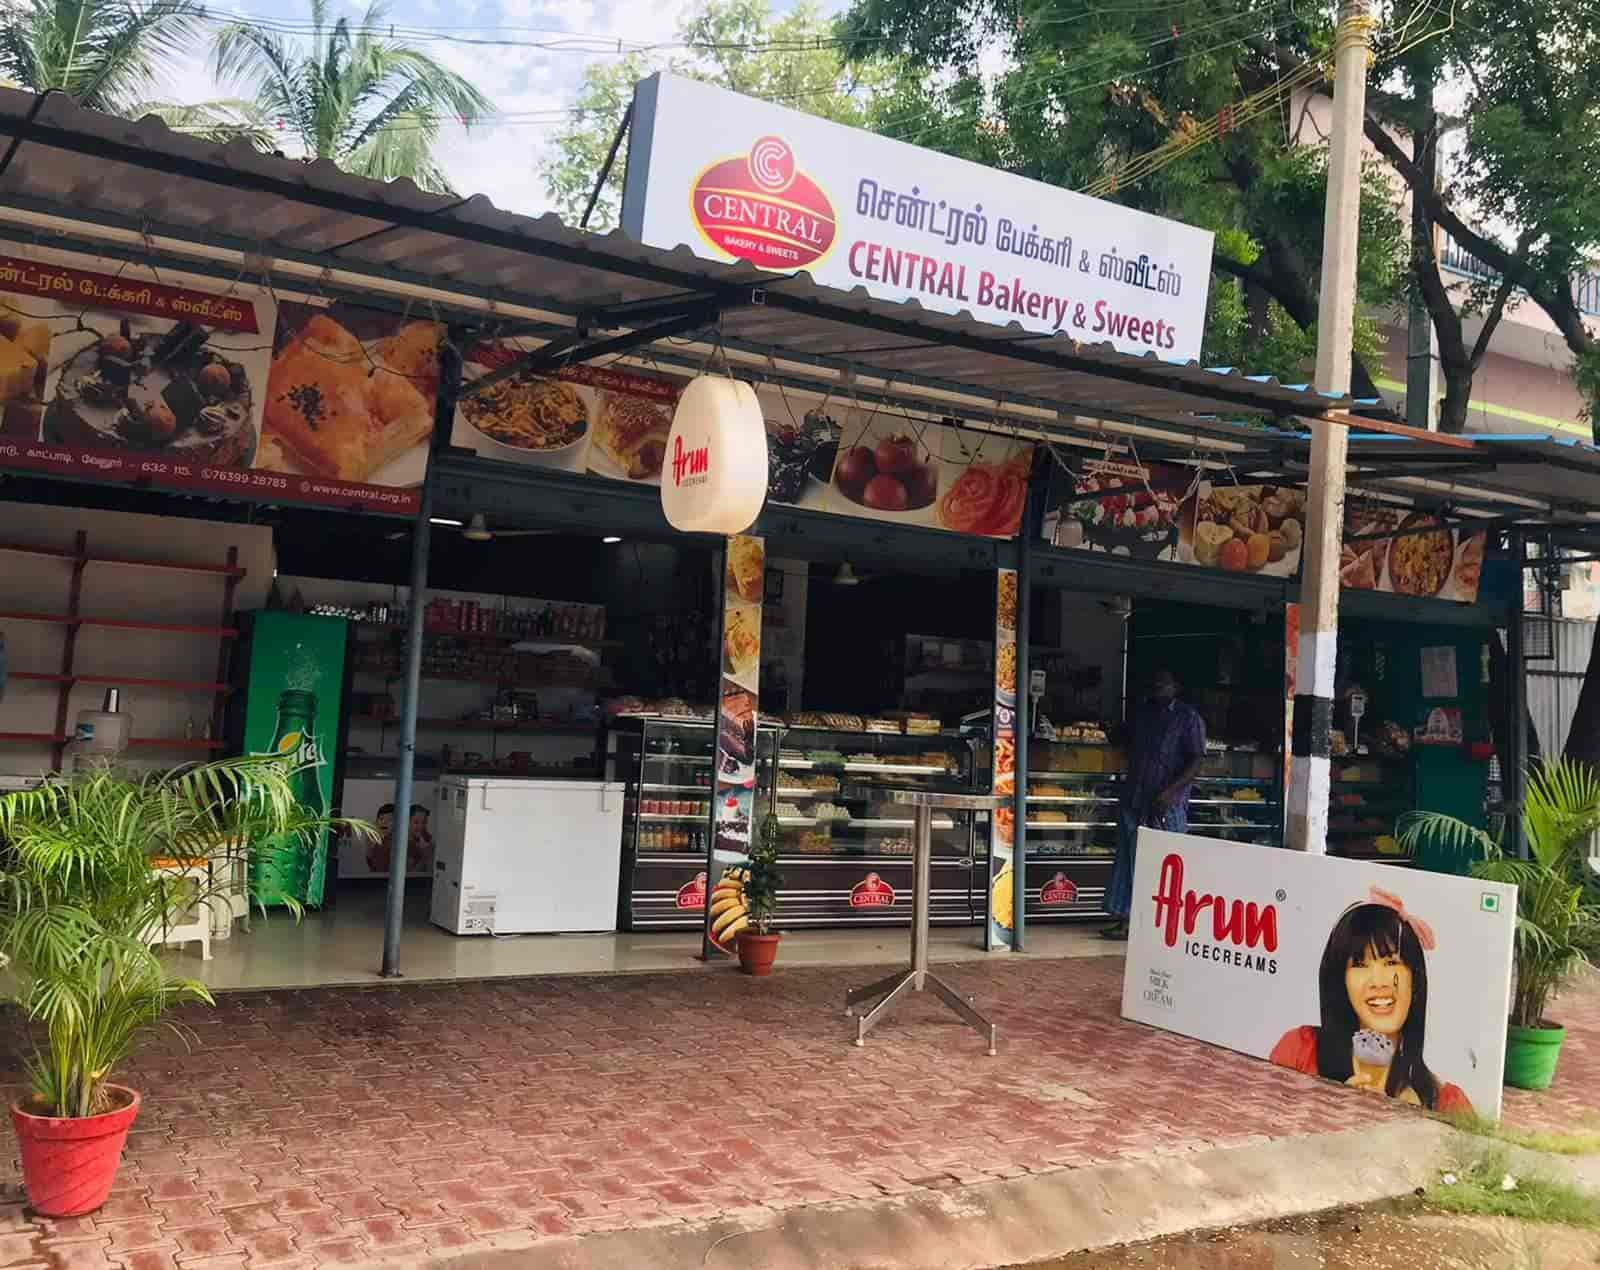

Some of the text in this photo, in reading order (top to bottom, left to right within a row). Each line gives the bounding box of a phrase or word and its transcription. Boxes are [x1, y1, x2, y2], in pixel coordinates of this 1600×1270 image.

[703, 194, 822, 244] CENTRAL
[856, 178, 1181, 297] சென்ட்ரல் பேக்கரி & ஸ்வீட்ஸ்
[723, 235, 799, 260] BAKERY & SWEETS
[79, 279, 152, 305] பேக்கரி
[848, 240, 1176, 350] CENTRAL Bakery & Sweets
[141, 462, 168, 473] 632
[671, 434, 709, 488] Arun
[680, 895, 705, 906] CENT
[1152, 853, 1278, 953] Arun
[1185, 940, 1278, 974] ICECREAMS
